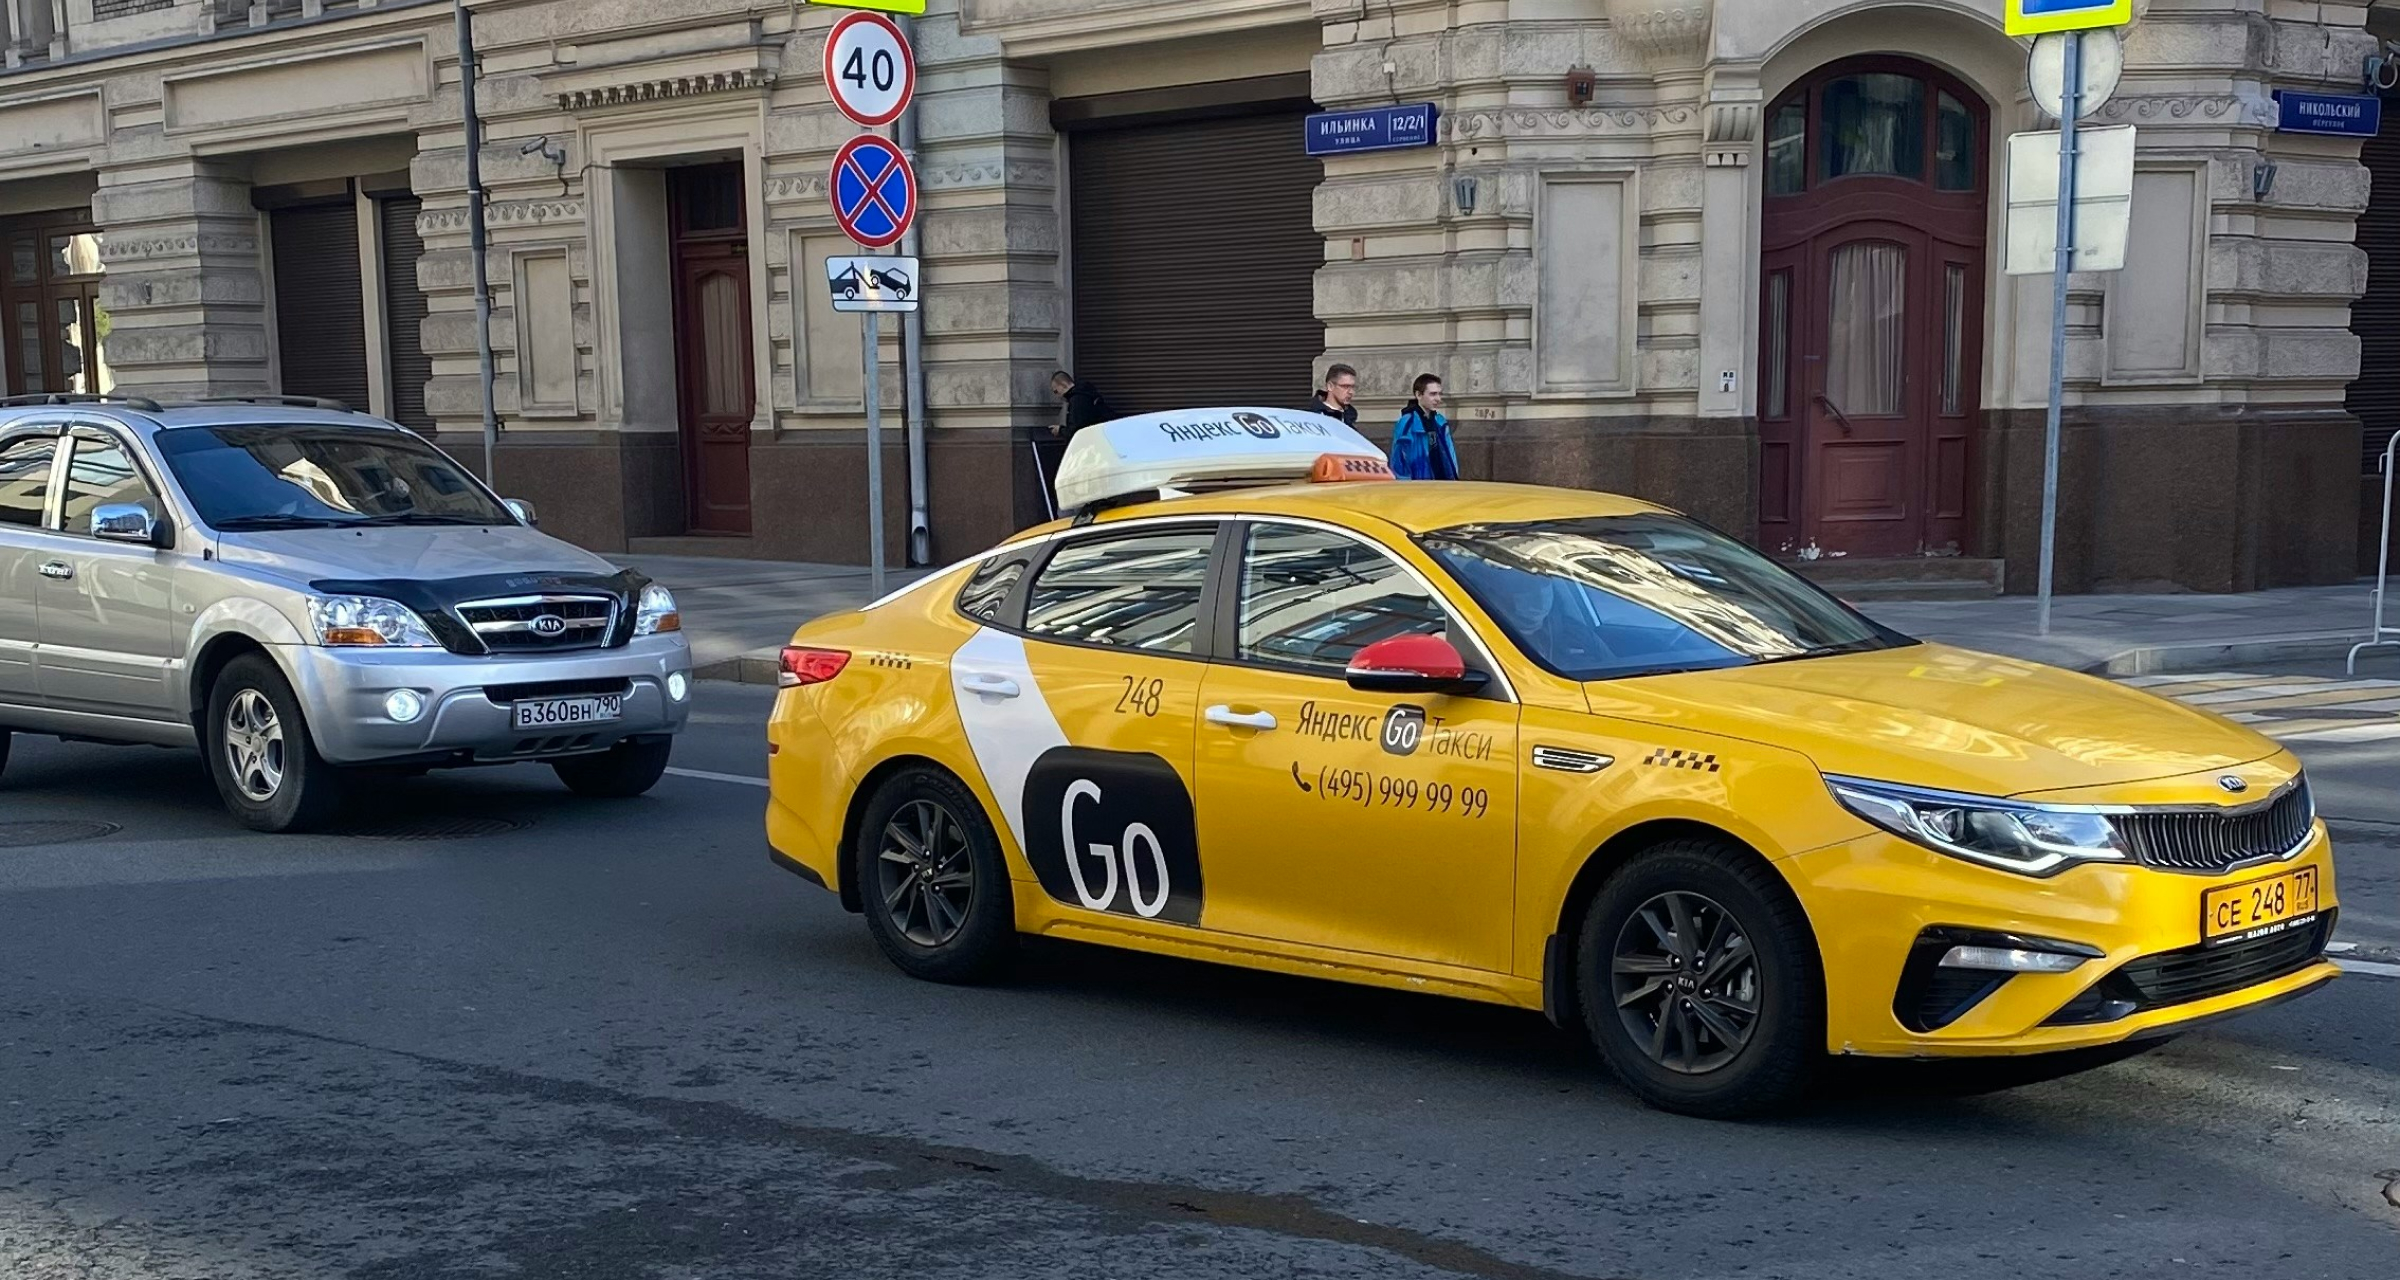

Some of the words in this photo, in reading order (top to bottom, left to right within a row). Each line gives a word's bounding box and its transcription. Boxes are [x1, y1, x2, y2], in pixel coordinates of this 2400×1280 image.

[843, 46, 894, 91] 40
[1392, 115, 1425, 132] 12/2/1
[2298, 101, 2361, 118] НИКОЛЬСКИЙ
[1320, 117, 1376, 136] ИЛЬИНКА
[1159, 420, 1242, 443] Яндекс
[1234, 413, 1275, 434] Go
[1268, 415, 1333, 438] Такси
[539, 619, 562, 630] KIA
[521, 701, 592, 724] В360ВН
[594, 697, 619, 713] 790
[1114, 675, 1164, 718] 248
[1295, 701, 1377, 743] Яндекс
[1385, 709, 1417, 749] Go
[1428, 716, 1494, 762] Такси
[1318, 765, 1373, 808] (495)
[1379, 775, 1419, 809] 999
[1426, 782, 1453, 813] 99
[1461, 786, 1489, 819] 99
[1061, 778, 1170, 918] Go
[2251, 881, 2285, 922] 248
[2295, 872, 2310, 901] 77
[1677, 976, 1695, 989] KIA
